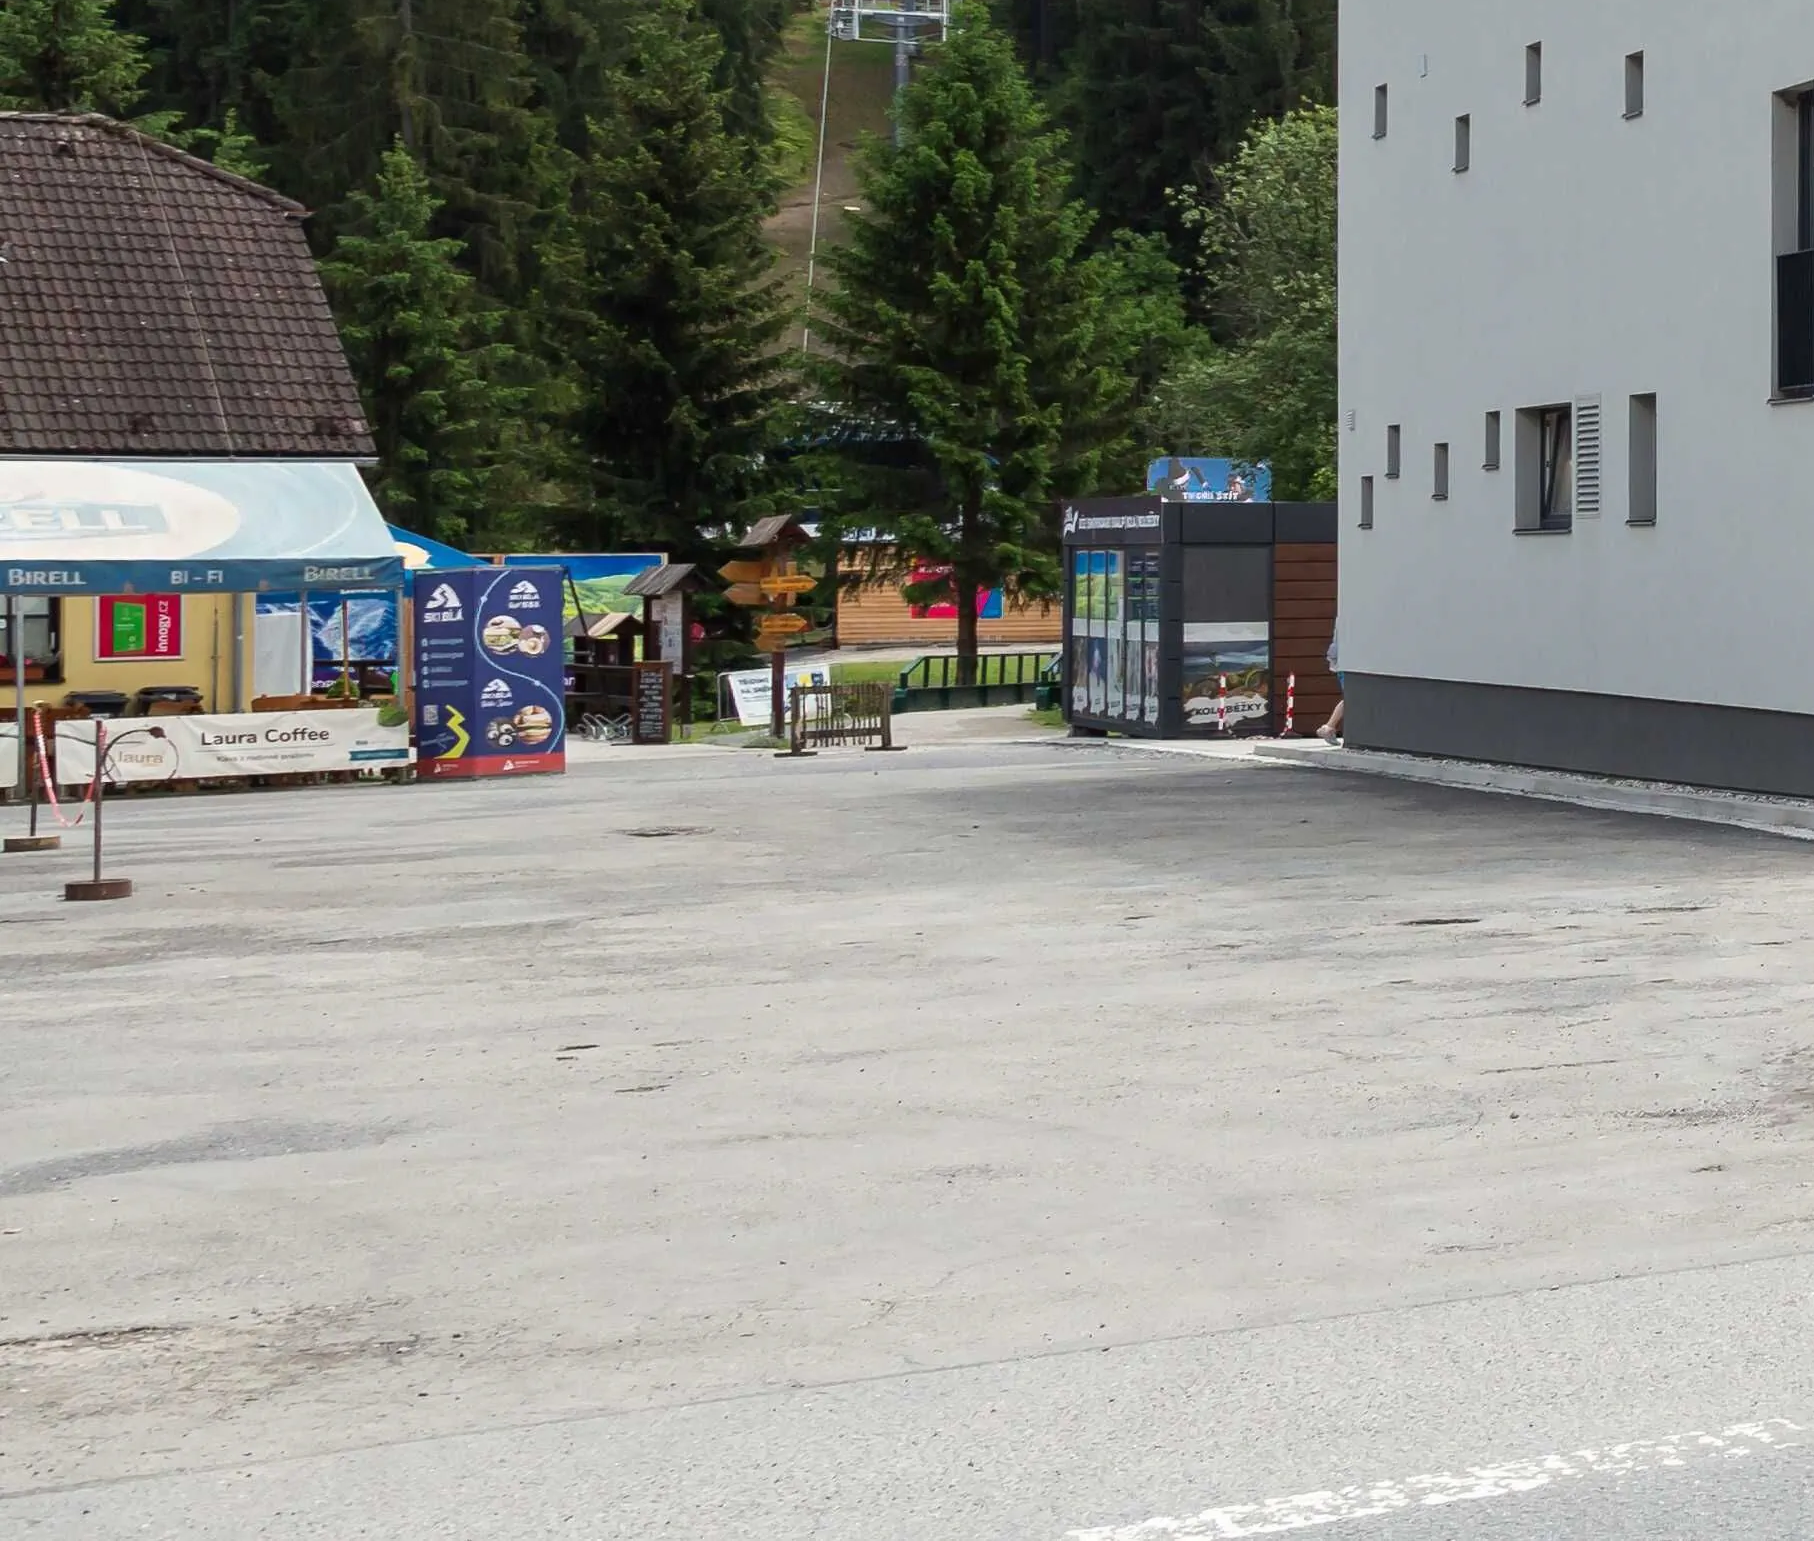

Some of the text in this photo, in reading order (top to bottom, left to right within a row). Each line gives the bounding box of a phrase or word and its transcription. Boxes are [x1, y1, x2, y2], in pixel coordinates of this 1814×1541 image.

[8, 568, 87, 586] BIRELL
[303, 566, 376, 582] BIRELL
[156, 600, 172, 653] innogy.cz
[1195, 701, 1262, 716] KOLBĚŽKY
[200, 728, 330, 747] Laura Coffee
[117, 750, 165, 765] laura
